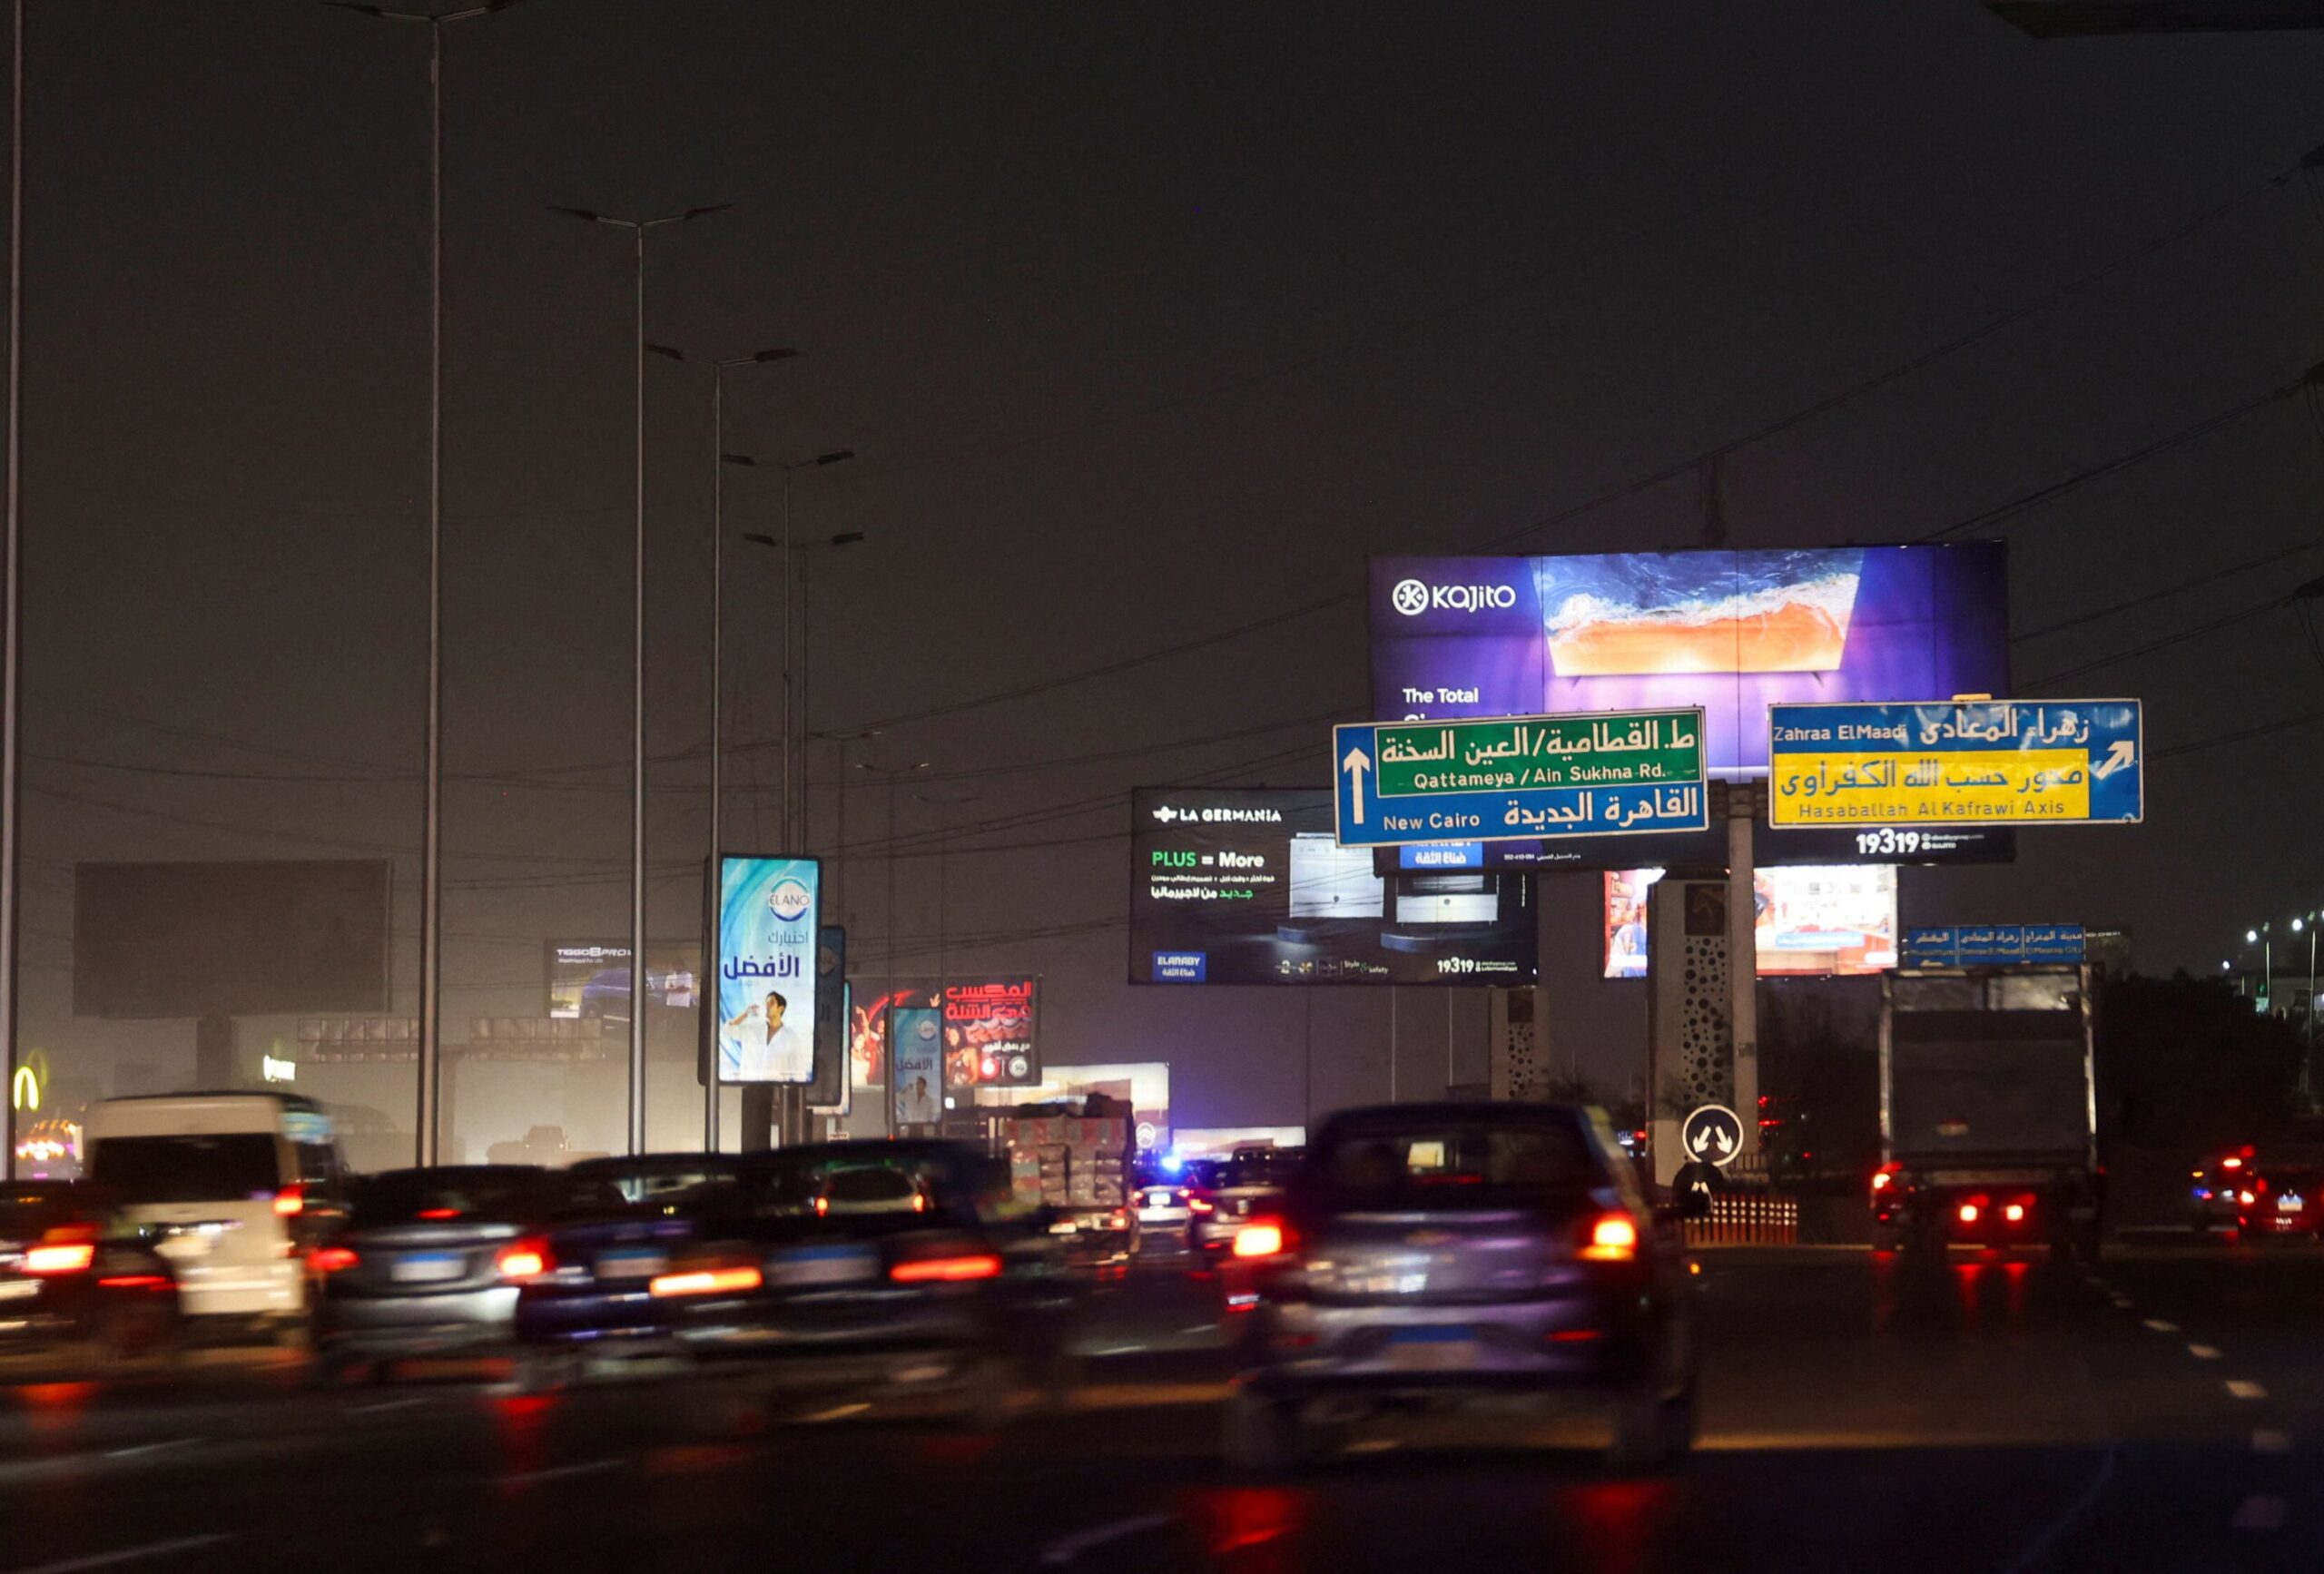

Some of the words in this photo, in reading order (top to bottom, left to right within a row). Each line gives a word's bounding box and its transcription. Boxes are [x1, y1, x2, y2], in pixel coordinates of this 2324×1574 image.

[1403, 687, 1434, 704] The
[1437, 687, 1480, 704] Total
[1773, 725, 1832, 743] Zahraa
[2025, 707, 2090, 744] زهراء
[1382, 729, 1455, 763] السخنة
[1413, 772, 1514, 791] Qattameya
[1570, 763, 1633, 782] Sukhna
[1639, 762, 1667, 779] Rd.
[1903, 757, 1939, 787] الله
[1945, 772, 2009, 796] حسب
[1179, 808, 1199, 821] LA
[1201, 808, 1283, 822] GERMANIA
[1503, 791, 1593, 831] الجديدة
[1604, 786, 1699, 828] القاهرة
[1798, 802, 1907, 819] Hasaballah
[2024, 800, 2066, 815] Axis
[1383, 815, 1423, 831] New
[1429, 812, 1481, 830] Cairo
[1856, 827, 1920, 854] 19319
[1152, 851, 1197, 868] PLUS
[1218, 851, 1265, 868] More
[768, 893, 810, 907] ELANO
[768, 930, 809, 947] اختيارك
[724, 951, 800, 980] الأفضل
[1437, 956, 1475, 973] 19319
[946, 981, 1031, 1003] المكسب
